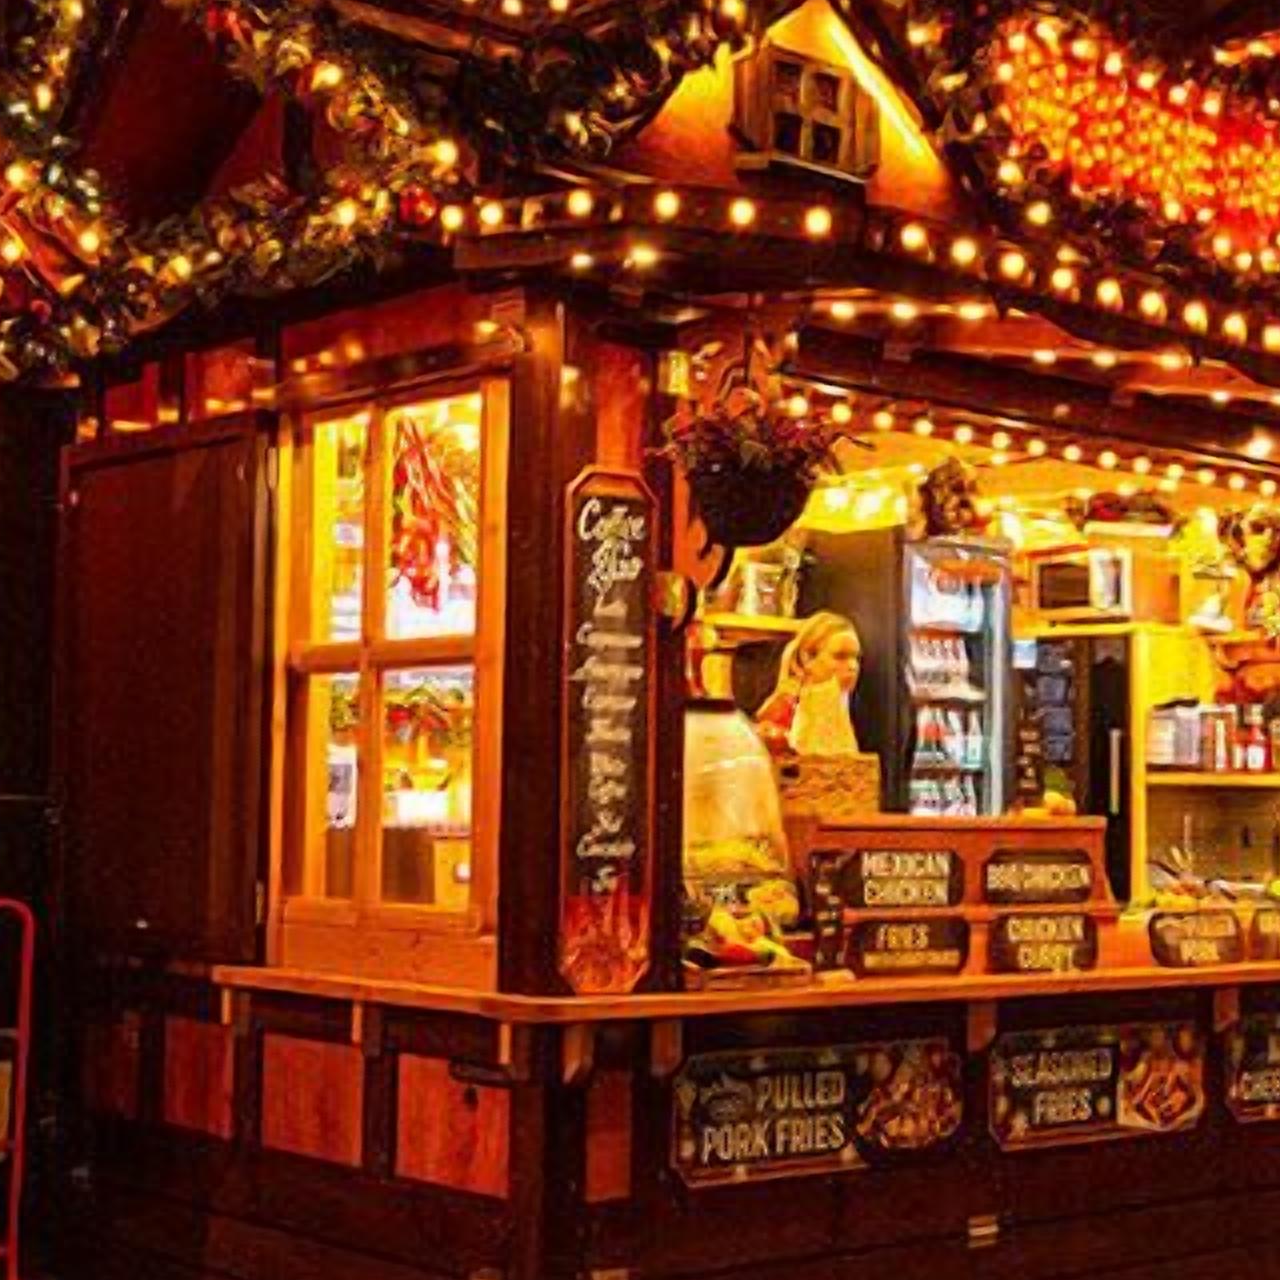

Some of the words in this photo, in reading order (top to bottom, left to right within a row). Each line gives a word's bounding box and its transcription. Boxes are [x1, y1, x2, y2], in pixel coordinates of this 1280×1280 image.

[861, 851, 951, 877] MEXICAN
[863, 879, 951, 906] CHICKEN
[875, 922, 930, 950] FRIES
[1011, 1048, 1113, 1087] SEASONED
[755, 1071, 846, 1111] PULLED
[1035, 1088, 1093, 1123] FRIES
[701, 1119, 769, 1165] PORK
[774, 1115, 845, 1155] FRIES
